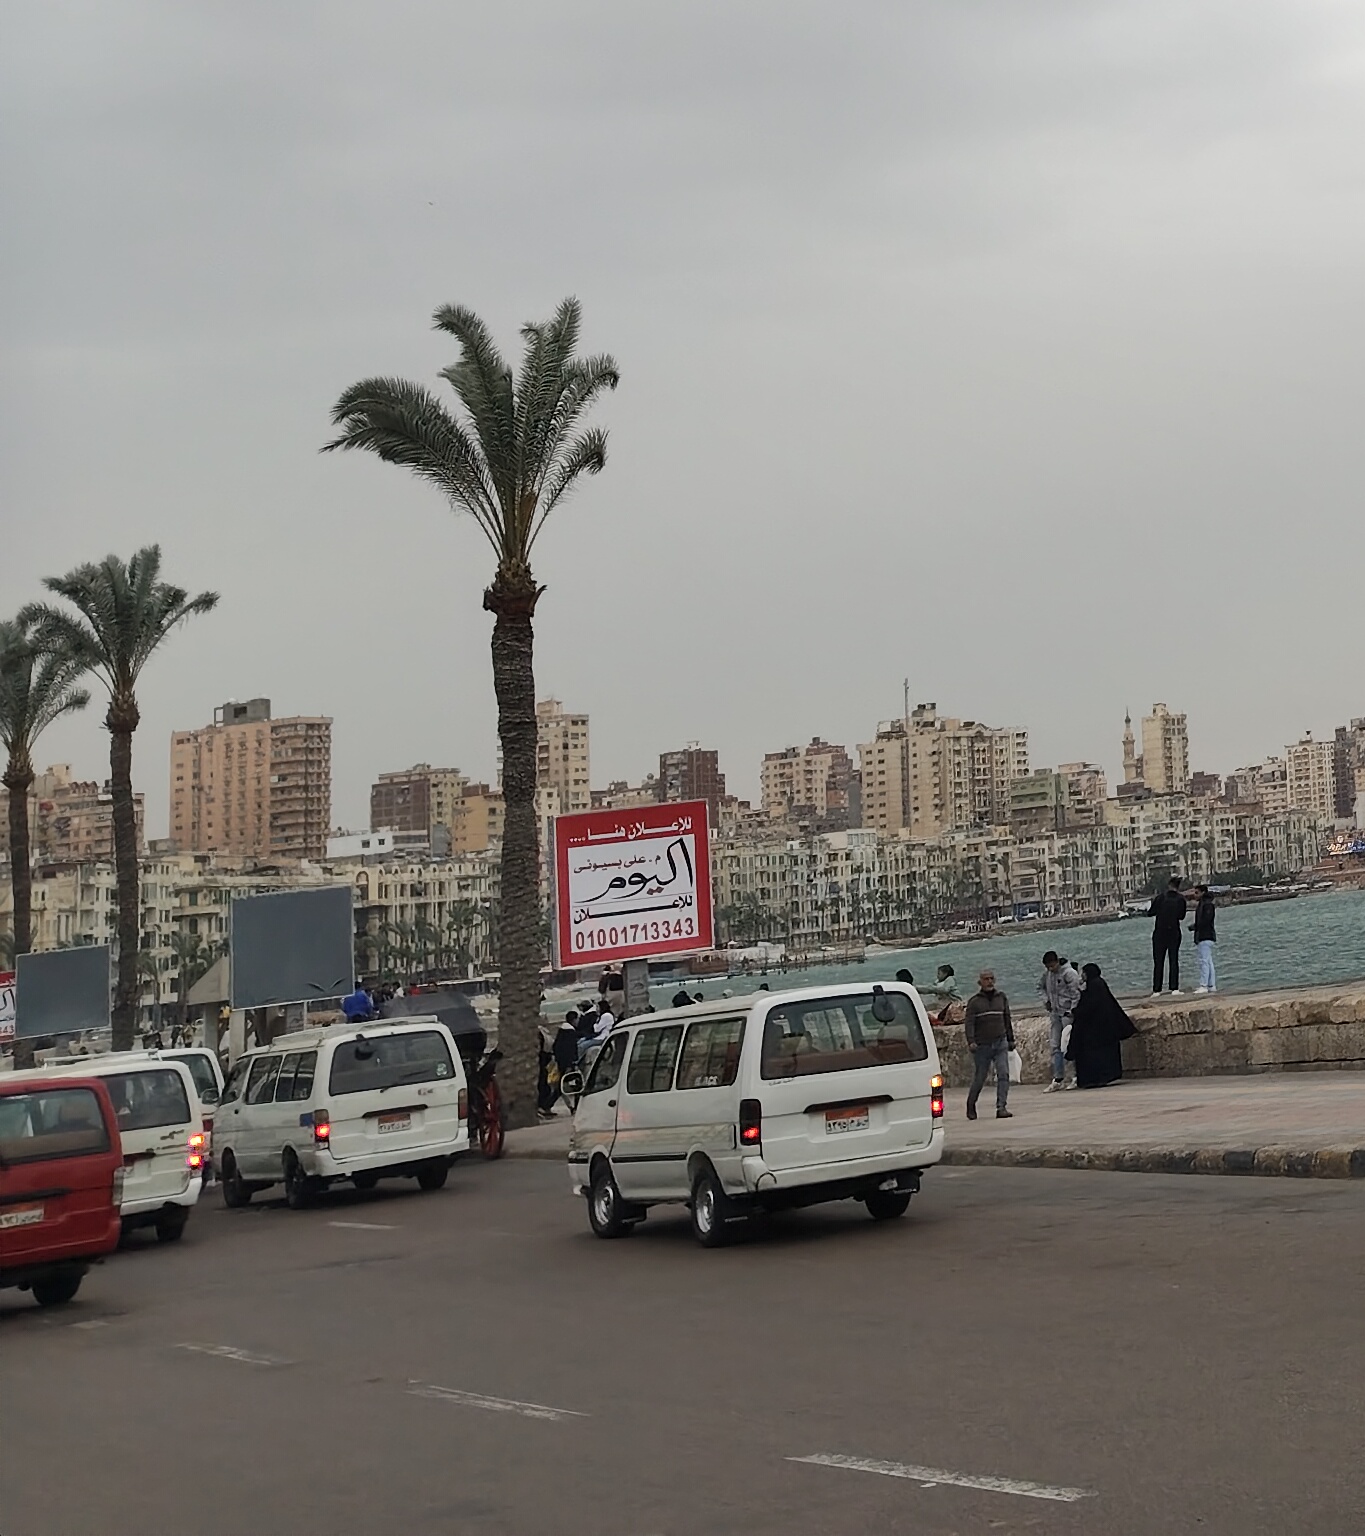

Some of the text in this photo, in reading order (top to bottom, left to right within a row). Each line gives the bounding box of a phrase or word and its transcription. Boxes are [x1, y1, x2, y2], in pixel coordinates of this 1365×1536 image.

[627, 816, 692, 840] للإعلان
[573, 837, 694, 904] اليوم
[573, 894, 693, 925] للإعلان
[575, 917, 694, 950] 01001713343
